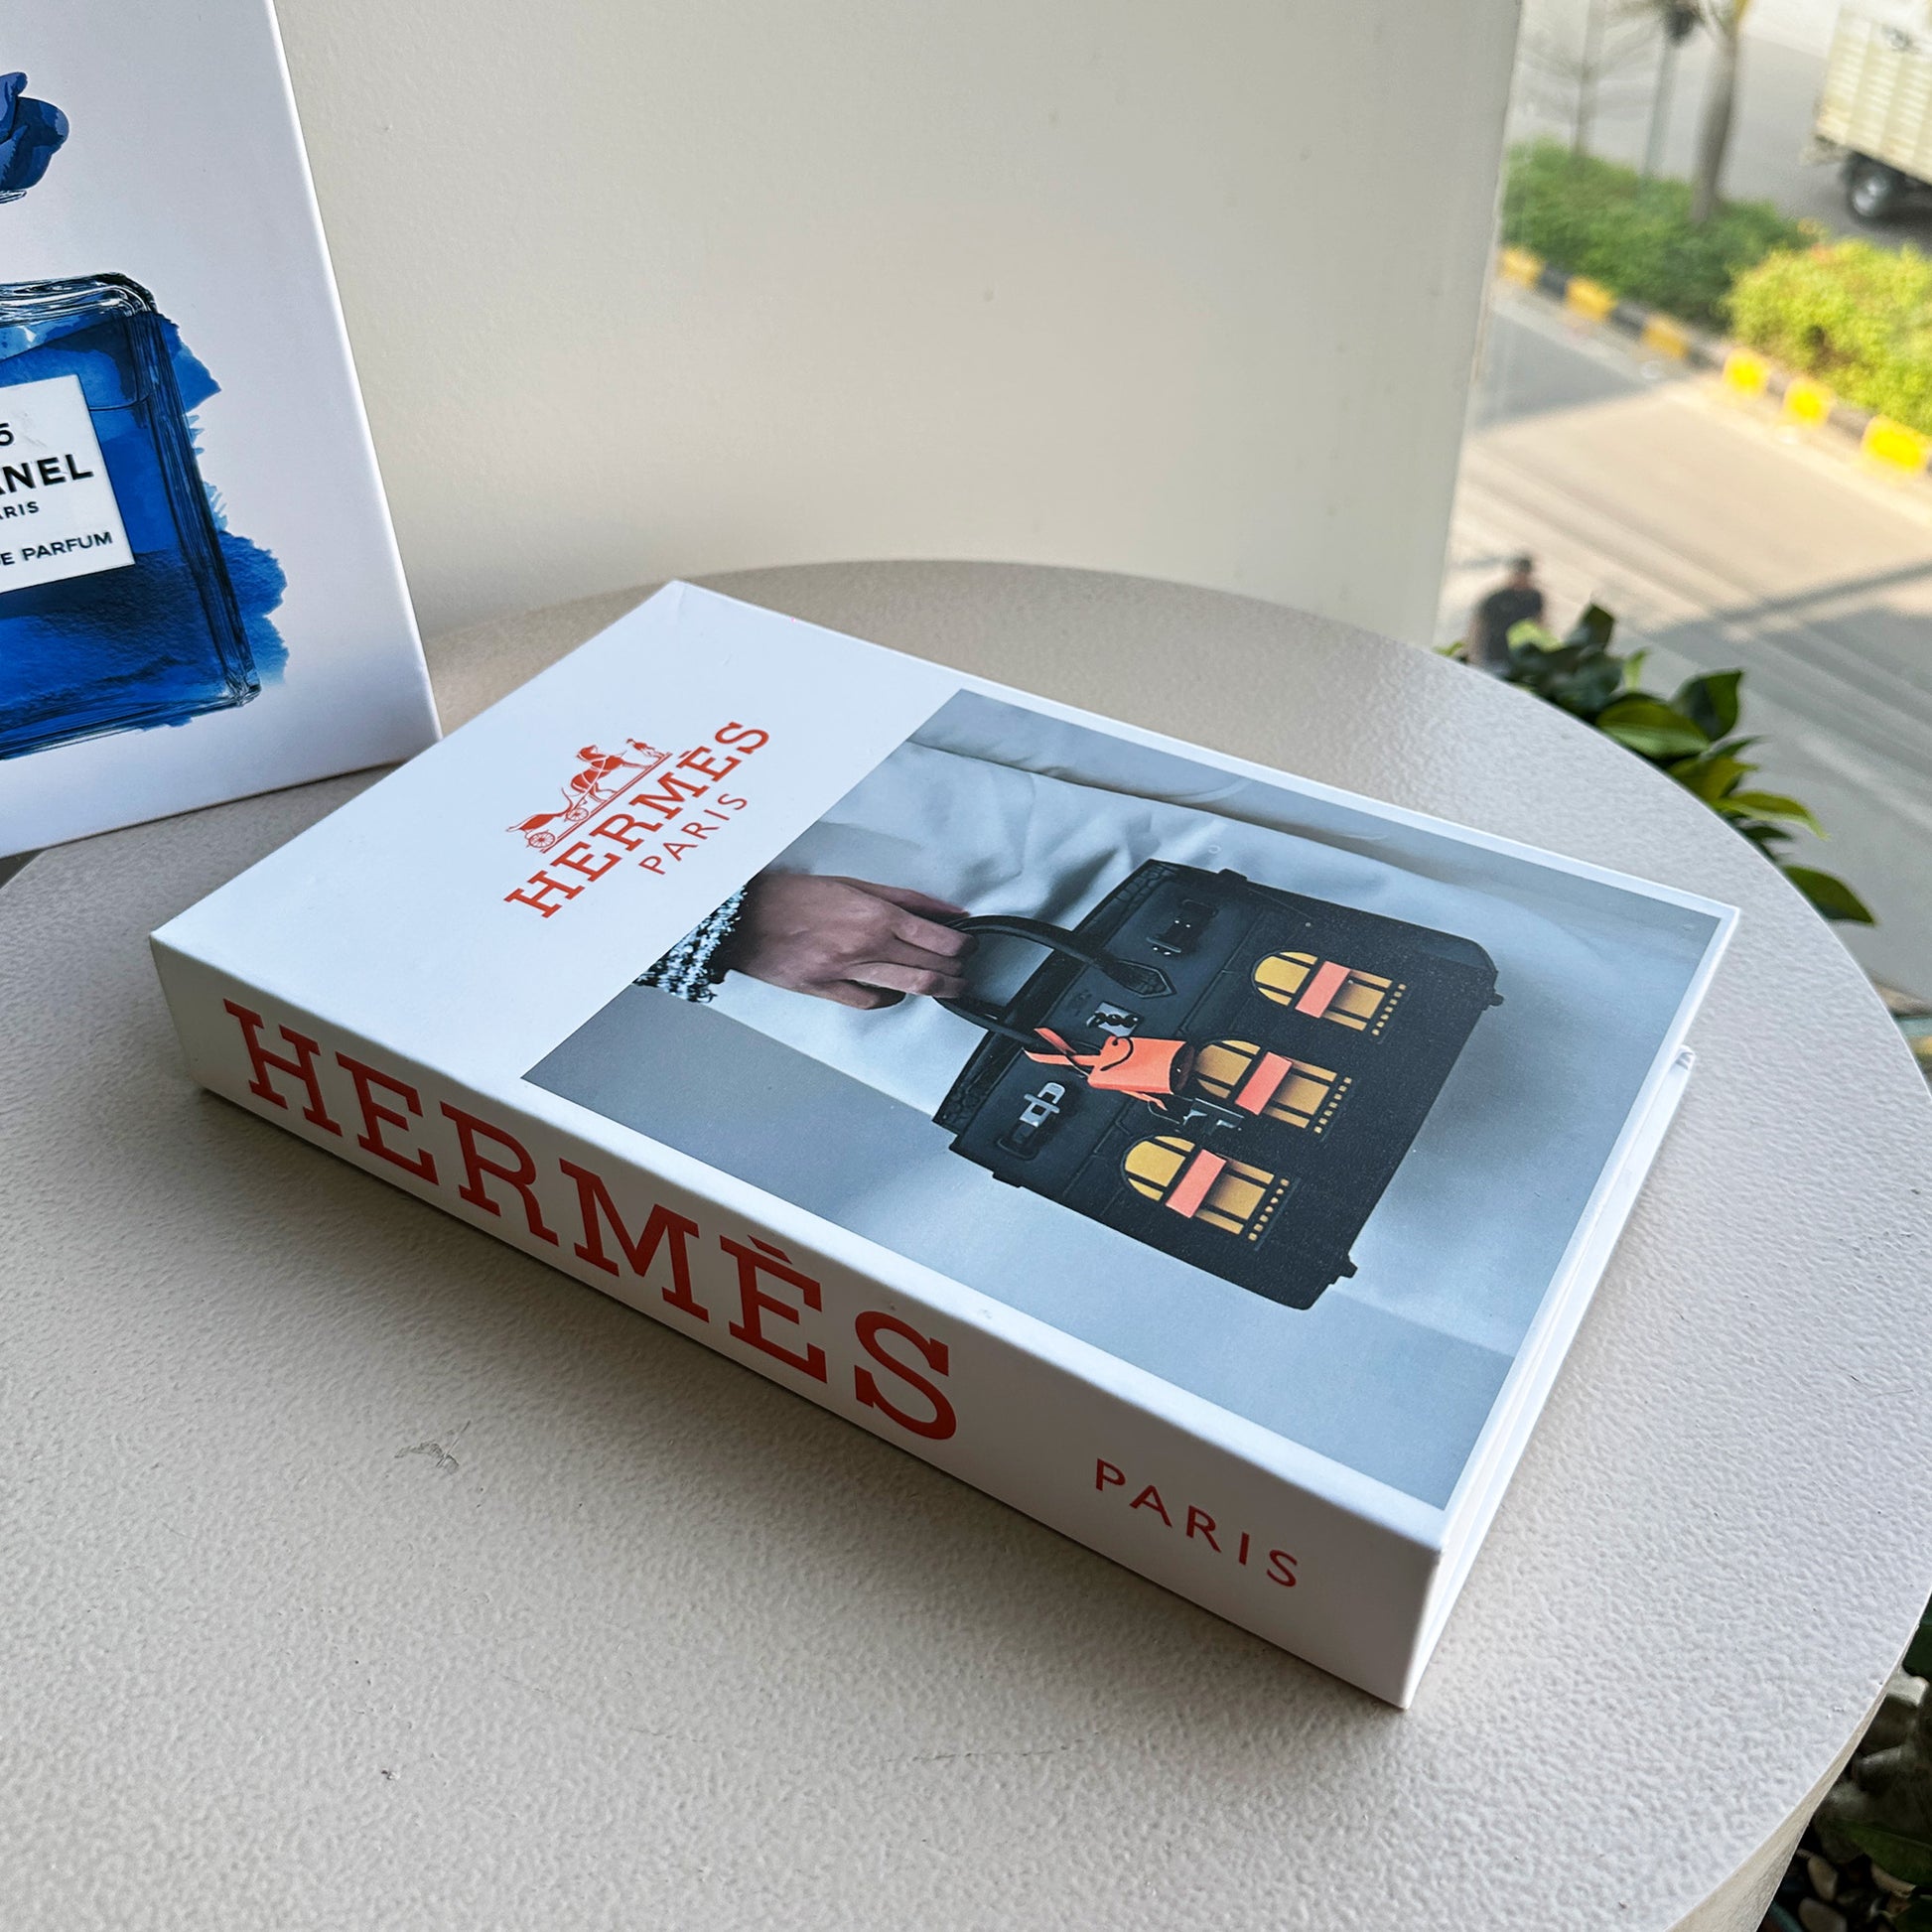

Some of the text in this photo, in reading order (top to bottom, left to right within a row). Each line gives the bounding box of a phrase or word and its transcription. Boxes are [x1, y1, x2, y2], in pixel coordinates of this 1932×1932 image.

[0, 454, 93, 495] NEL
[0, 501, 39, 519] RIS
[0, 531, 112, 565] E PARFUM
[503, 722, 769, 917] HERMÈS
[638, 793, 748, 875] PARIS
[223, 999, 1298, 1587] HERMÈS PARIS
